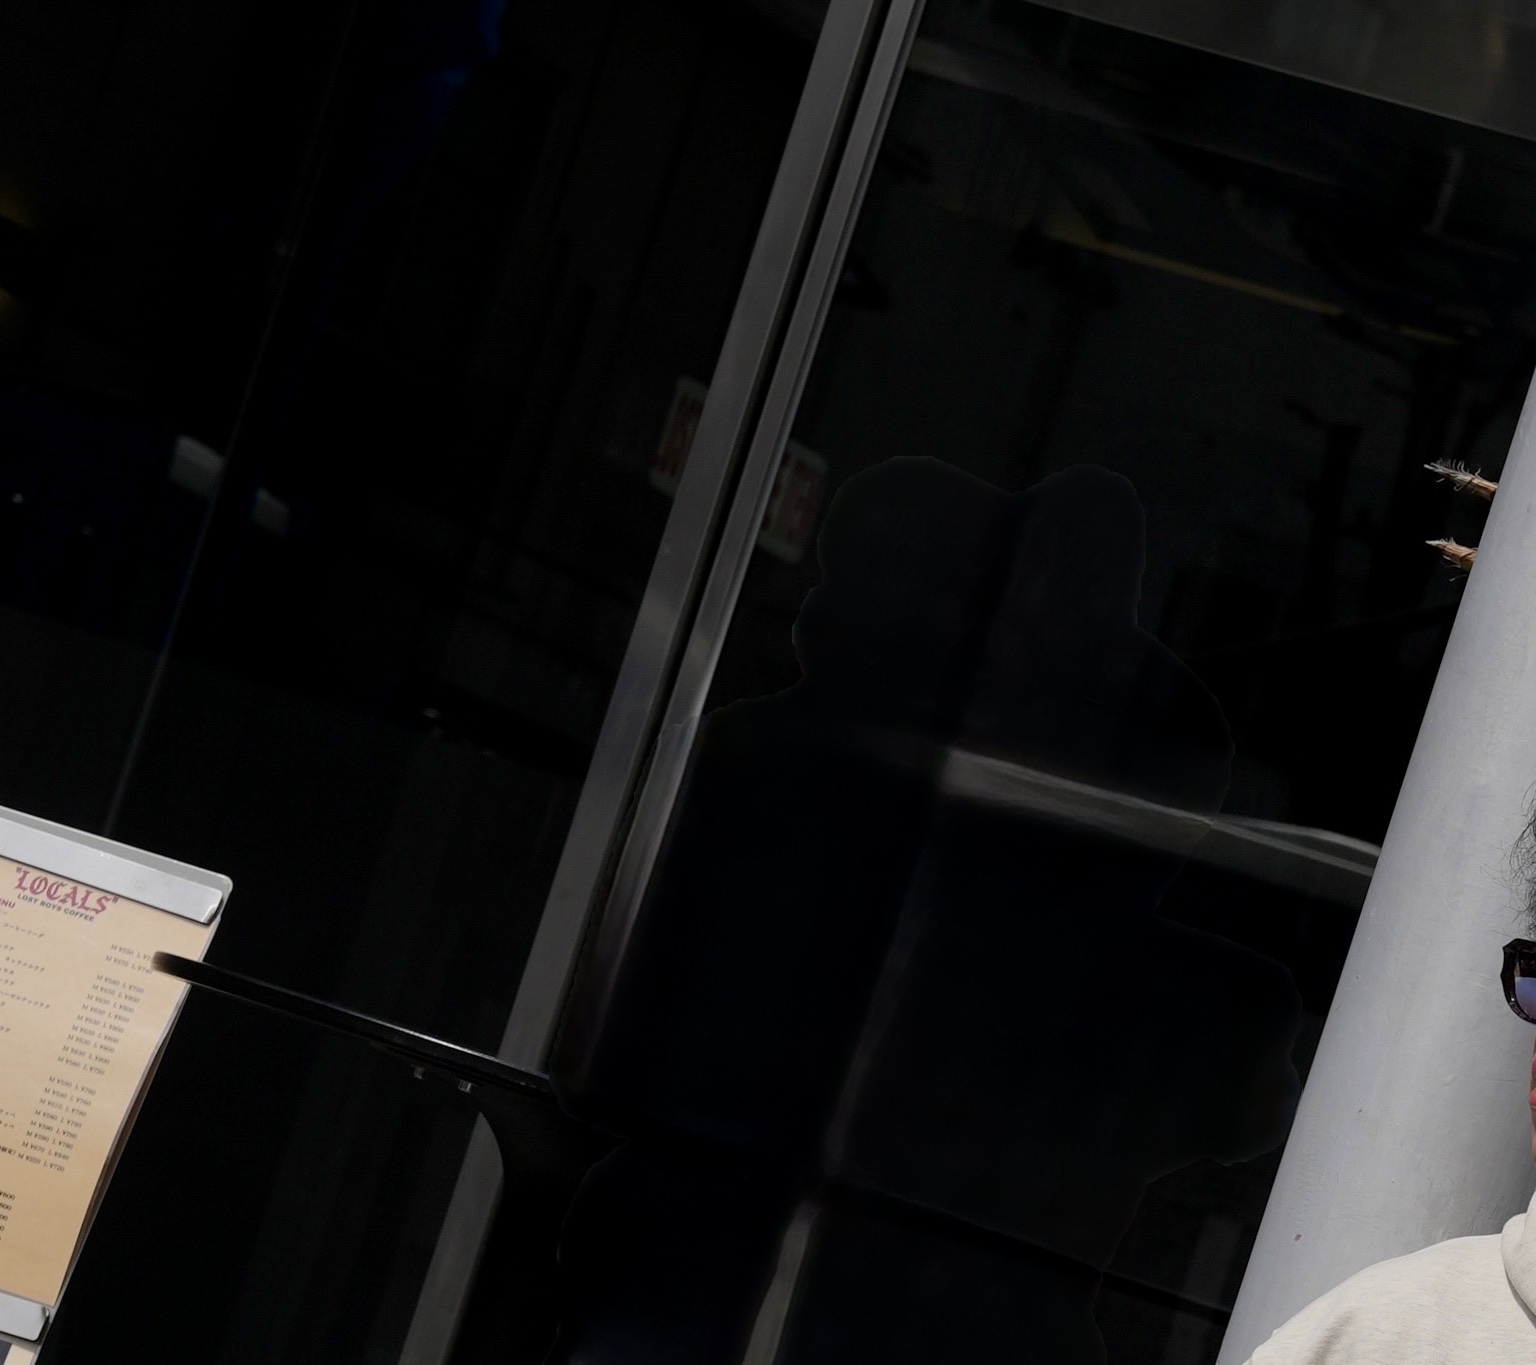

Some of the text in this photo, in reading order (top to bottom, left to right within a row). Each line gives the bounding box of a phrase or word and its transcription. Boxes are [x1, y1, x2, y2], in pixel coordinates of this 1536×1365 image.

[17, 893, 95, 922] LOST BOYS COFFEE
